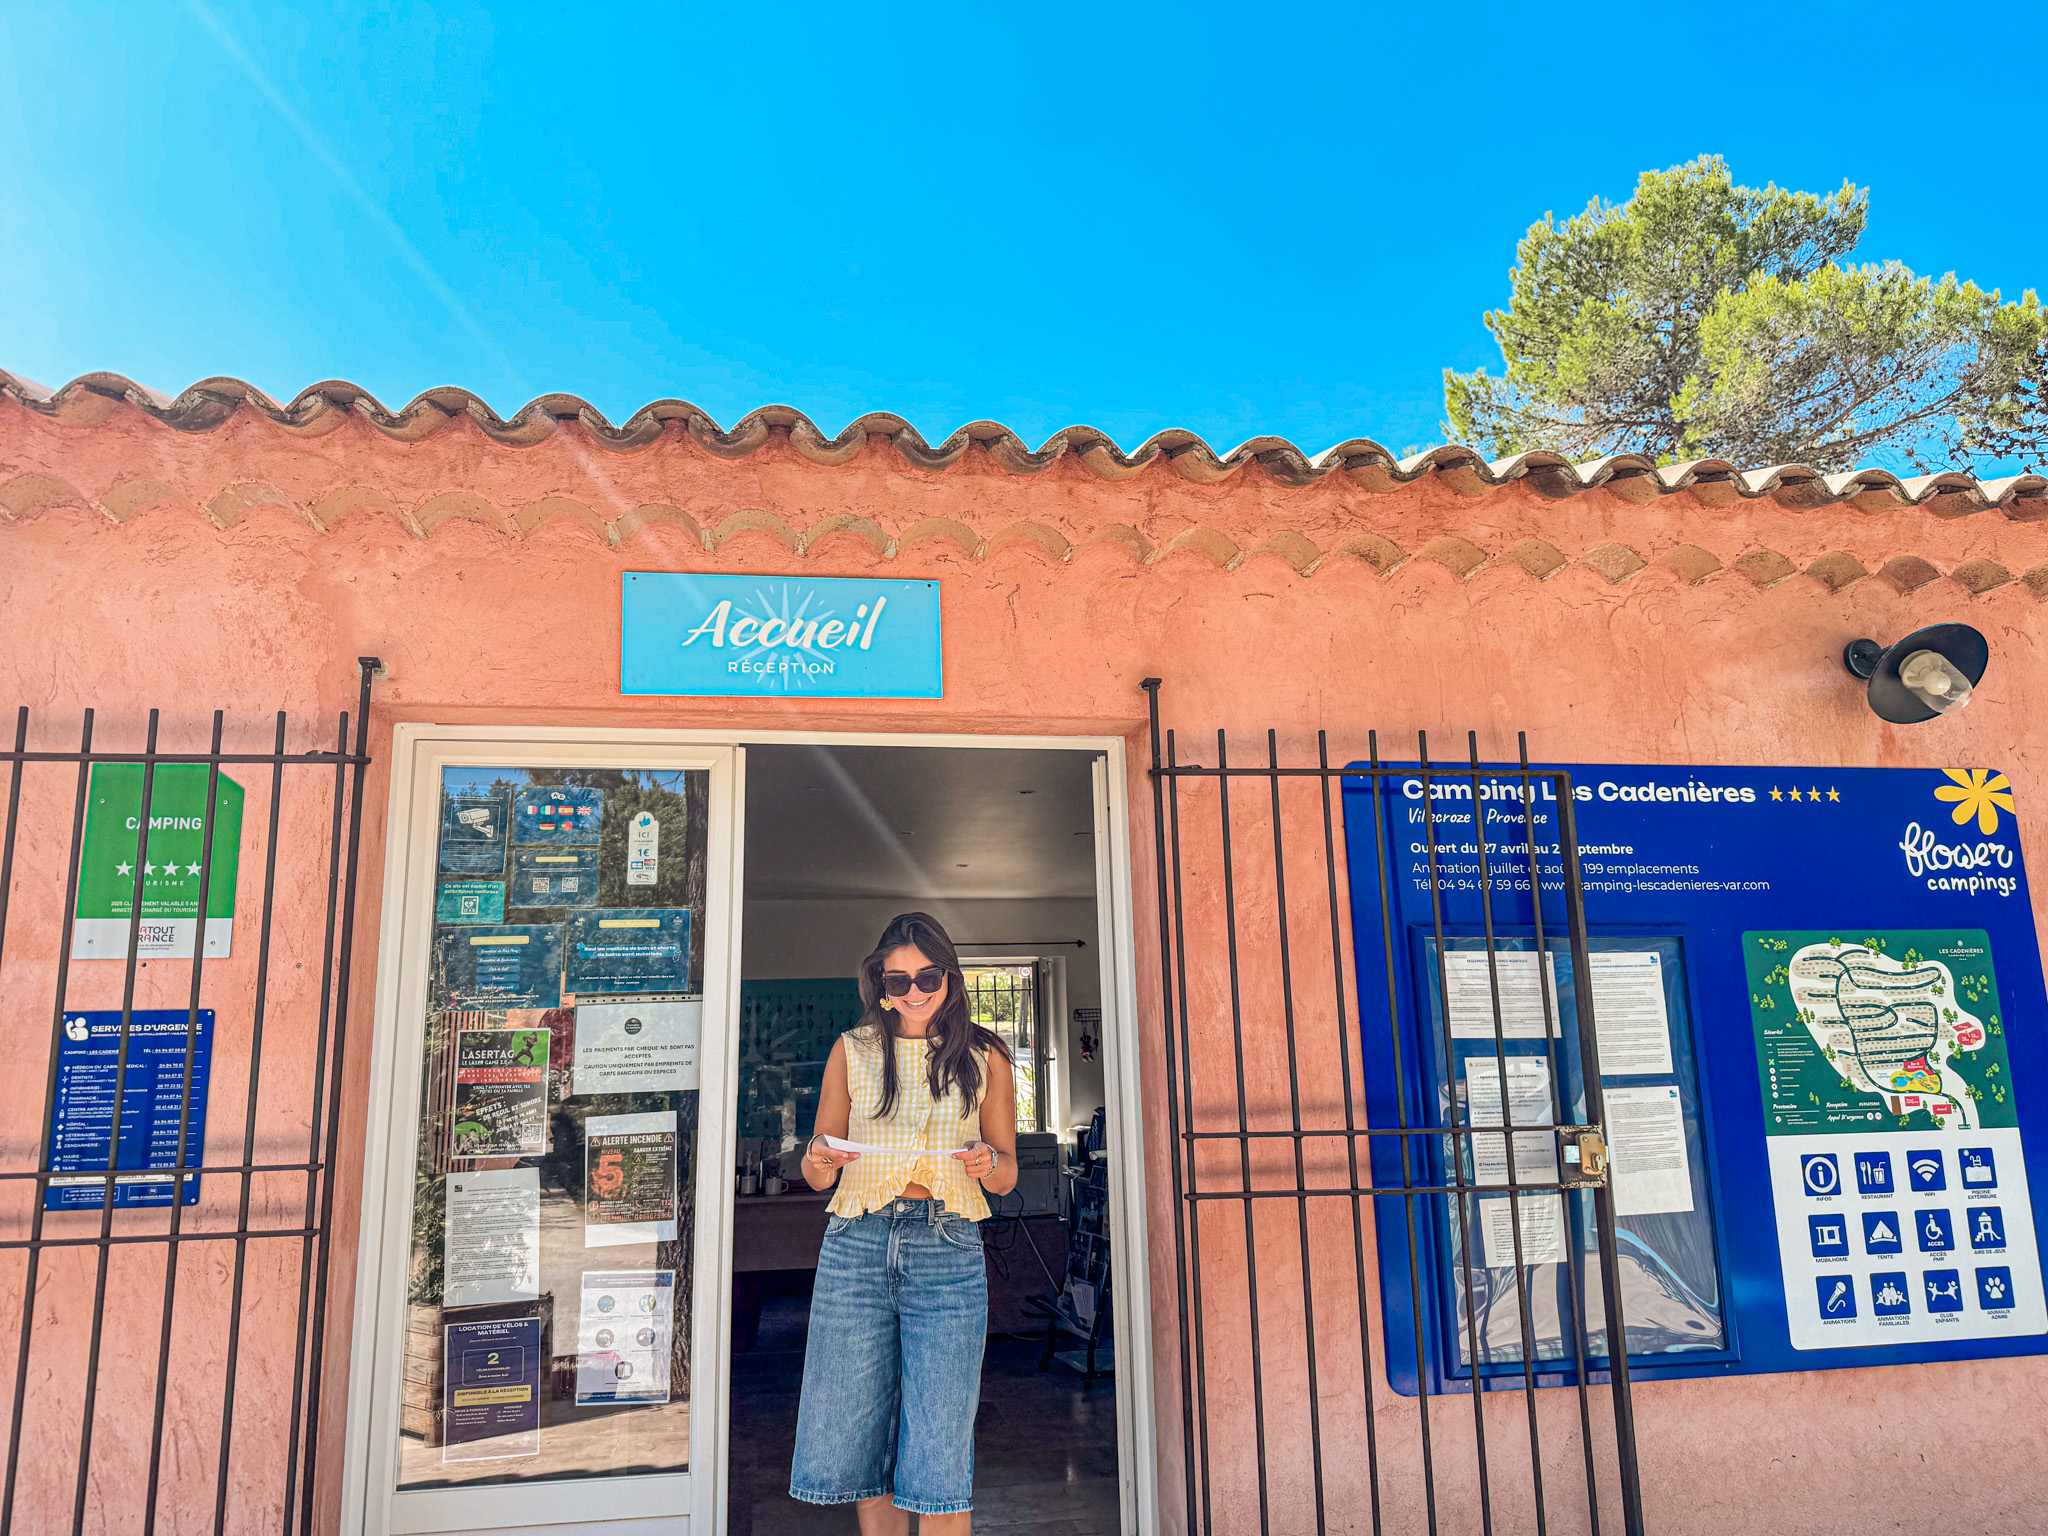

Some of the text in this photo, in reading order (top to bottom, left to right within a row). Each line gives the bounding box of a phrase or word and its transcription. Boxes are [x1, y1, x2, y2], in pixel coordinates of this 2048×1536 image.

[681, 596, 887, 650] Accueil
[728, 659, 834, 674] RÉCEPTION
[1402, 779, 1756, 804] Camping Cadenières
[1408, 807, 1548, 825] Vilecroze Provece
[638, 848, 650, 857] 1€
[1460, 842, 1478, 854] du
[1483, 843, 1497, 854] 27
[1500, 842, 1529, 854] avril
[1534, 844, 1549, 854] au
[1898, 821, 2014, 877] flower
[1412, 862, 1480, 874] Anmation
[1489, 861, 1524, 876] juillet
[1544, 862, 1564, 874] aoû
[1583, 863, 1604, 874] 199
[1606, 863, 1700, 877] emplacements
[1437, 879, 1455, 890] 04
[1458, 879, 1476, 890] 94
[1496, 879, 1512, 890] 59
[1514, 879, 1531, 890] 66
[1927, 871, 2017, 897] campings
[140, 926, 175, 934] ATOUT
[138, 934, 175, 942] RANCE
[91, 1023, 203, 1033] SERVIES D'URGENE
[462, 1049, 515, 1060] LASERTAG
[520, 1096, 543, 1108] SONORE
[475, 1102, 502, 1116] EFFETS
[602, 1134, 663, 1146] ALERTE INCENDIE
[598, 1154, 624, 1190] 5
[458, 1324, 492, 1332] LOCATION
[1822, 1318, 1857, 1326] ANIMATIONS
[487, 1352, 500, 1365] 2
